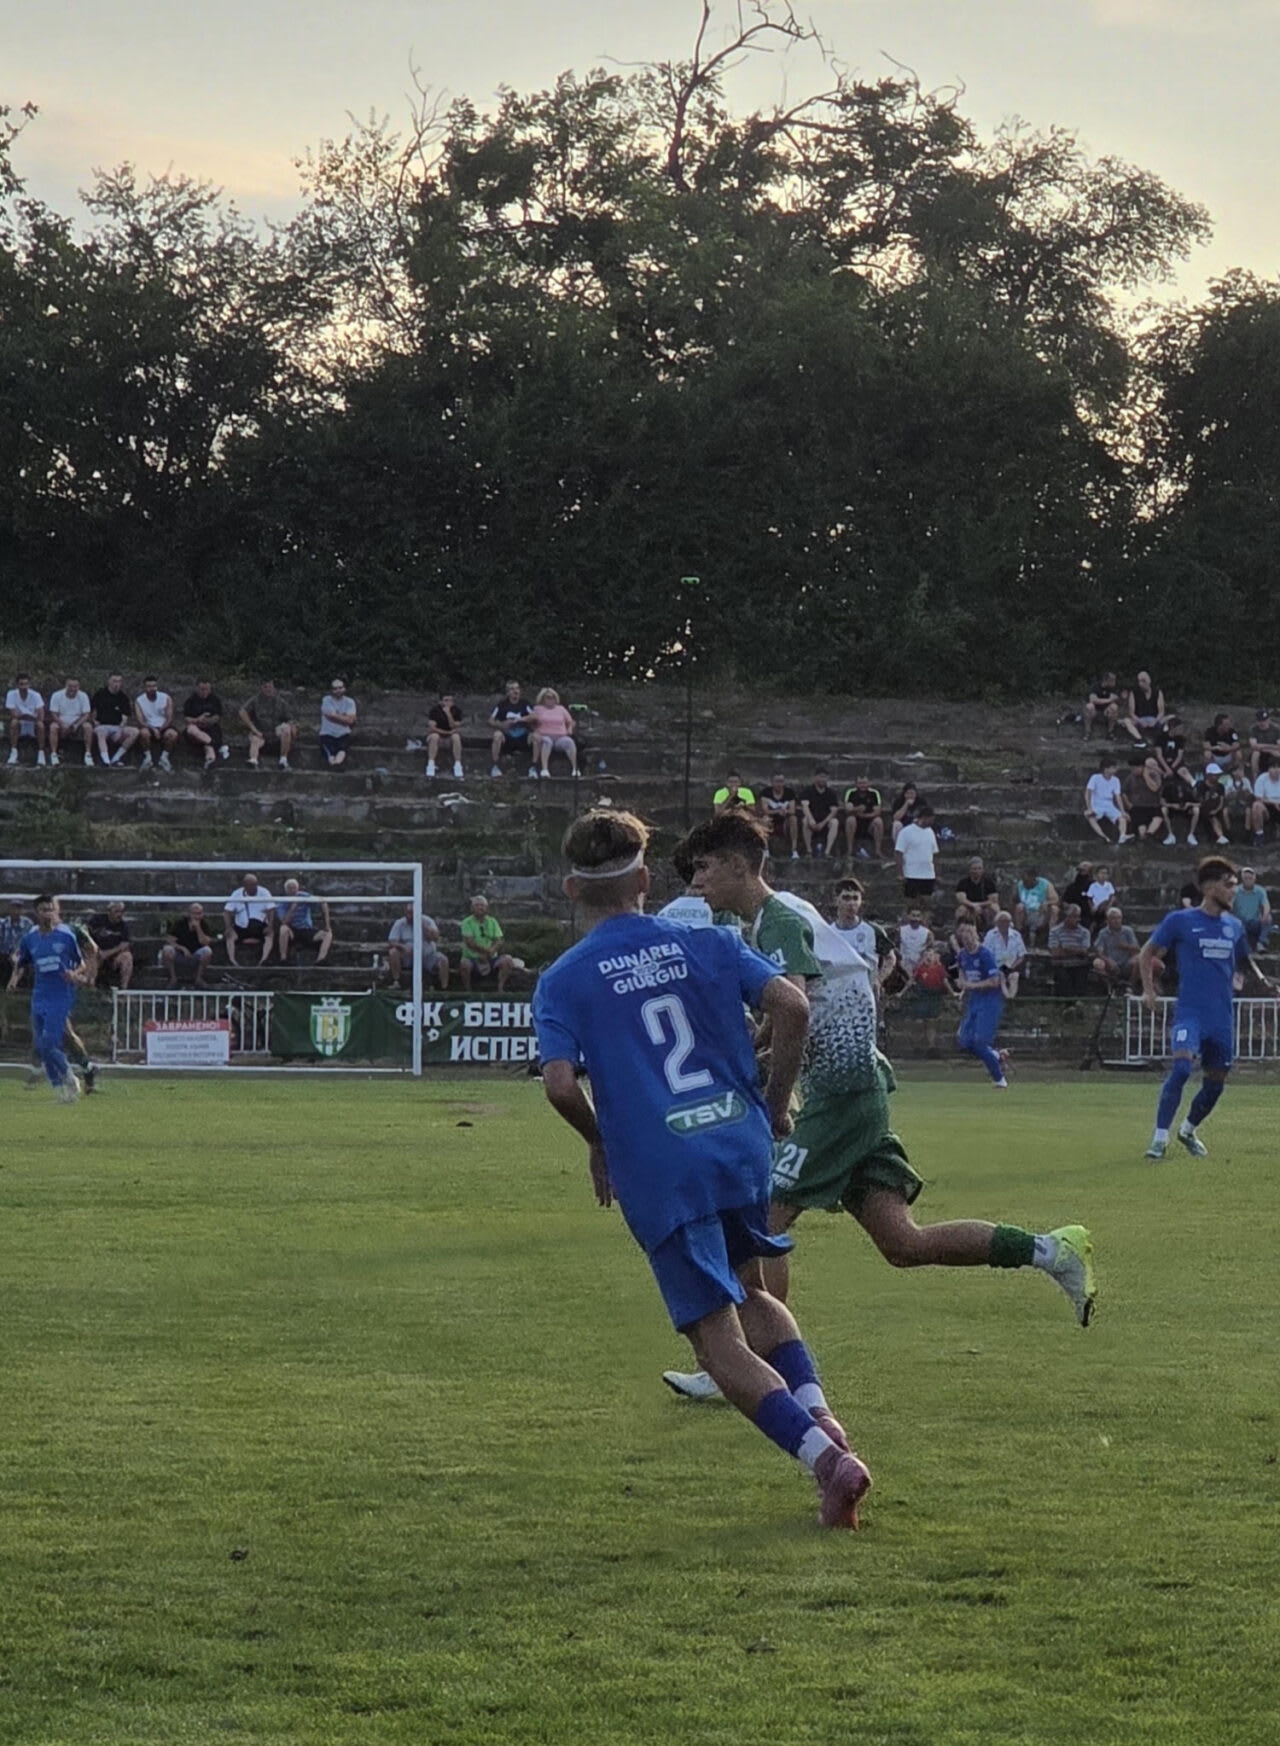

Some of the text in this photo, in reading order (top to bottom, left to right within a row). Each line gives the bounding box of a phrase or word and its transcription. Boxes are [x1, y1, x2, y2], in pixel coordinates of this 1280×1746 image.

[598, 942, 684, 975] DUNAREA
[612, 963, 688, 994] GIURGIU
[395, 1002, 444, 1026] ФК
[641, 993, 714, 1095] 2
[665, 1090, 736, 1129] TSV
[775, 1143, 809, 1179] 21
